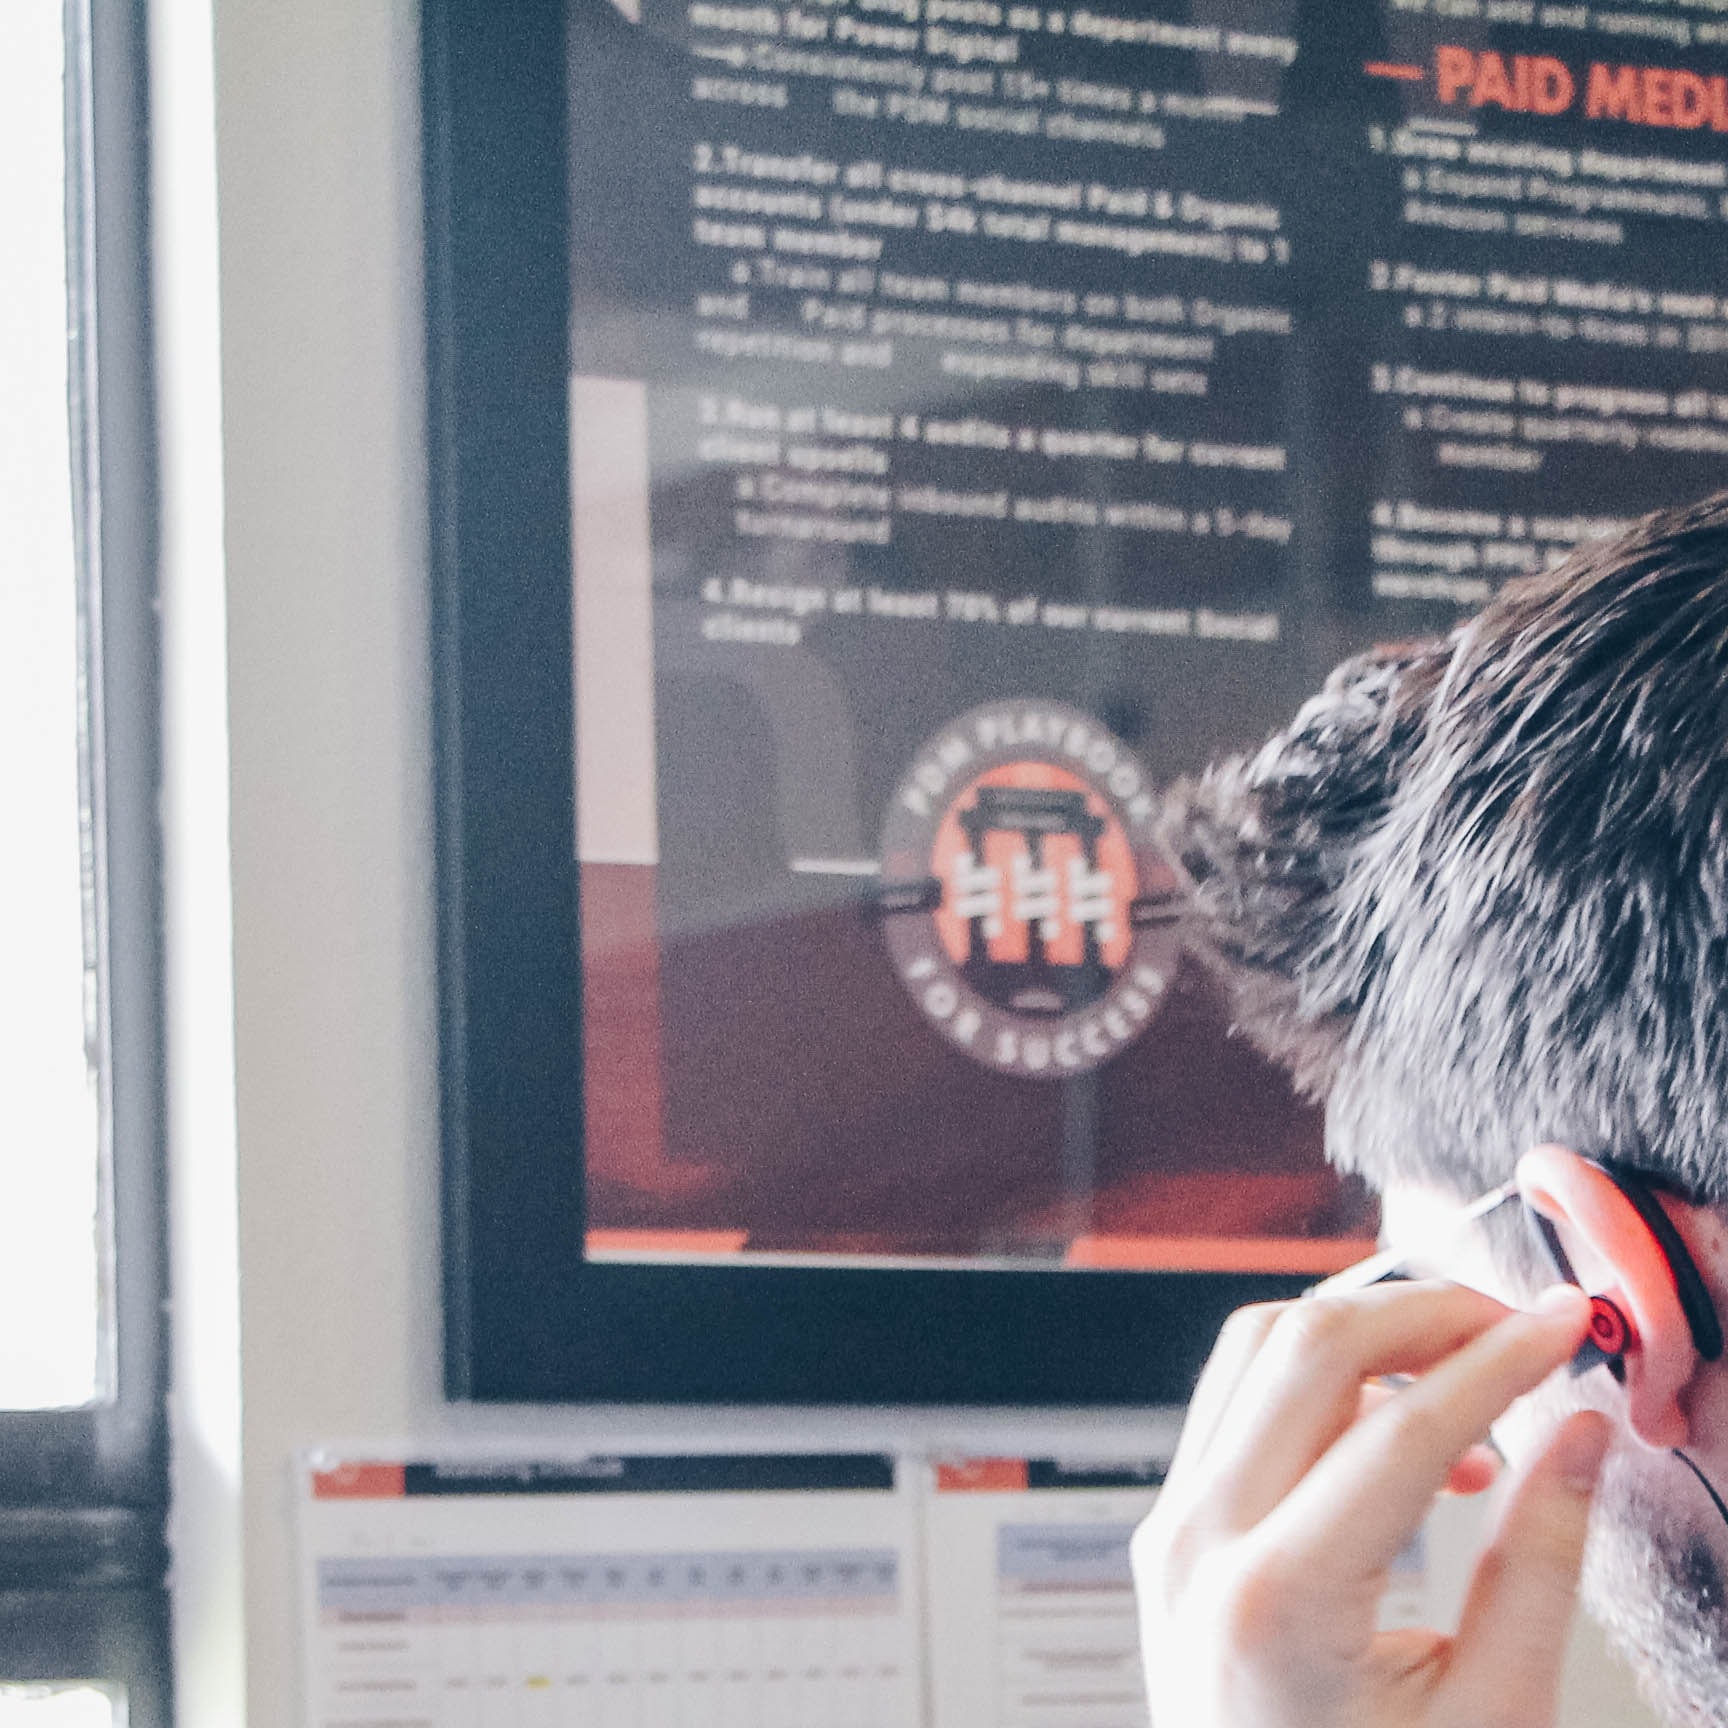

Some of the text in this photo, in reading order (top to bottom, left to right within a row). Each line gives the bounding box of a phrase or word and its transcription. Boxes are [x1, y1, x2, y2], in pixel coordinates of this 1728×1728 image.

[1434, 44, 1574, 116] PAID
[906, 957, 1164, 1071] FOR SUCCESS
